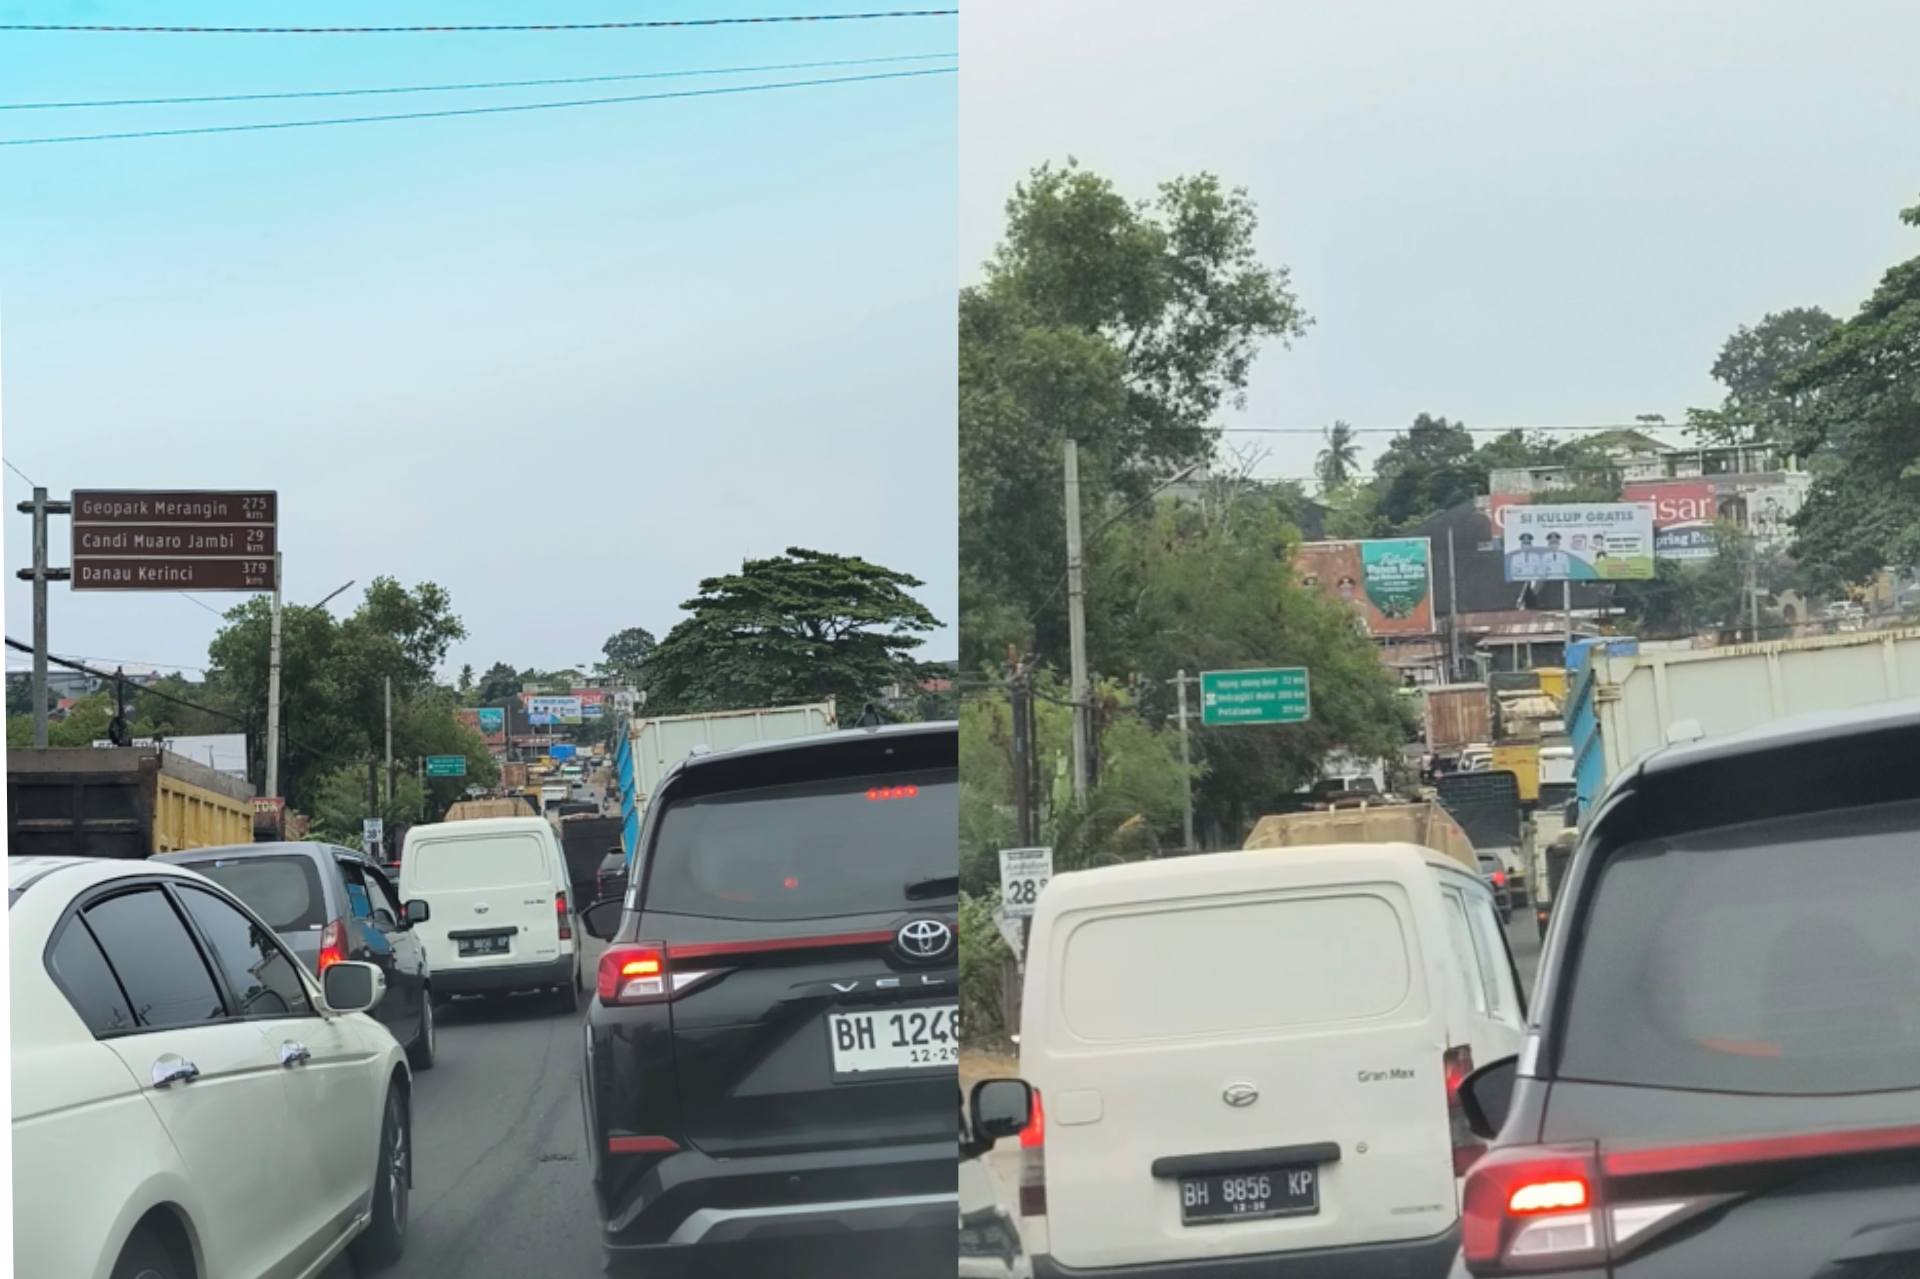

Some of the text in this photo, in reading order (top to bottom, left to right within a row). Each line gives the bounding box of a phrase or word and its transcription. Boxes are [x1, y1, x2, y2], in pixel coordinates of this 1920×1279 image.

[83, 500, 228, 518] Geopark Merangin
[242, 497, 267, 510] 275
[246, 510, 263, 519] km
[1520, 511, 1634, 524] SI KULUP GRATIS
[82, 533, 234, 549] Candi Muaro Jambi
[246, 530, 264, 542] 29
[246, 543, 264, 552] km
[83, 566, 193, 581] Danau Kerinci
[242, 562, 267, 574] 379
[246, 575, 263, 585] km
[830, 975, 946, 992] VEL
[835, 1009, 959, 1051] BH 1248
[1358, 1068, 1415, 1083] Gran Max
[1184, 1171, 1313, 1207] BH 8856 KP
